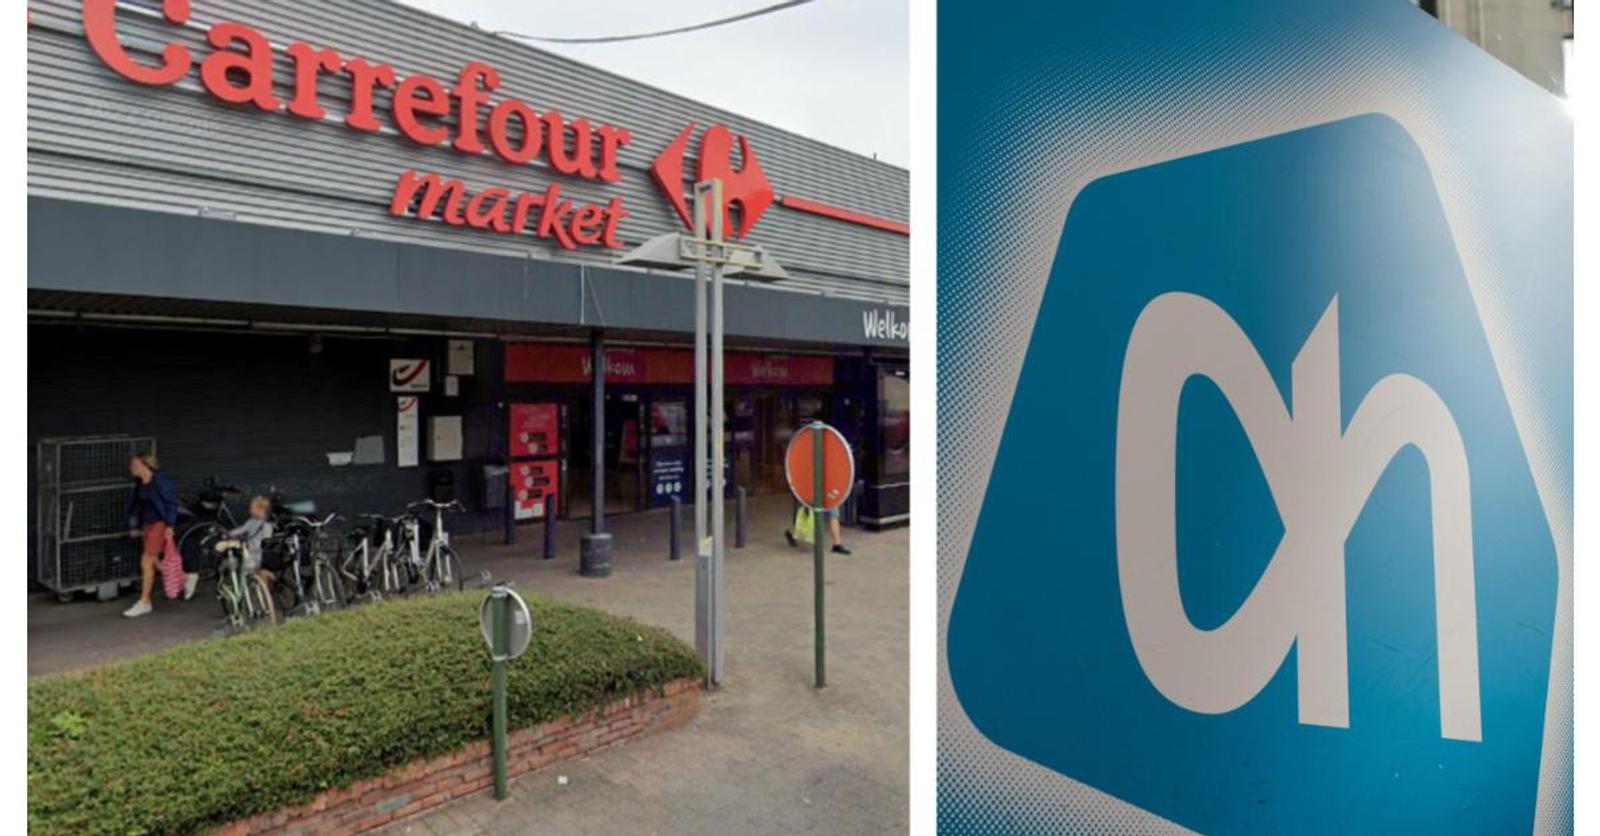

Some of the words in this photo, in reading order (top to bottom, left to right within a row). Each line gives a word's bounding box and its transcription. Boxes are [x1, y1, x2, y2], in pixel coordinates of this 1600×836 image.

[83, 0, 630, 183] Carrefour
[389, 168, 630, 250] market
[863, 309, 910, 339] Welko
